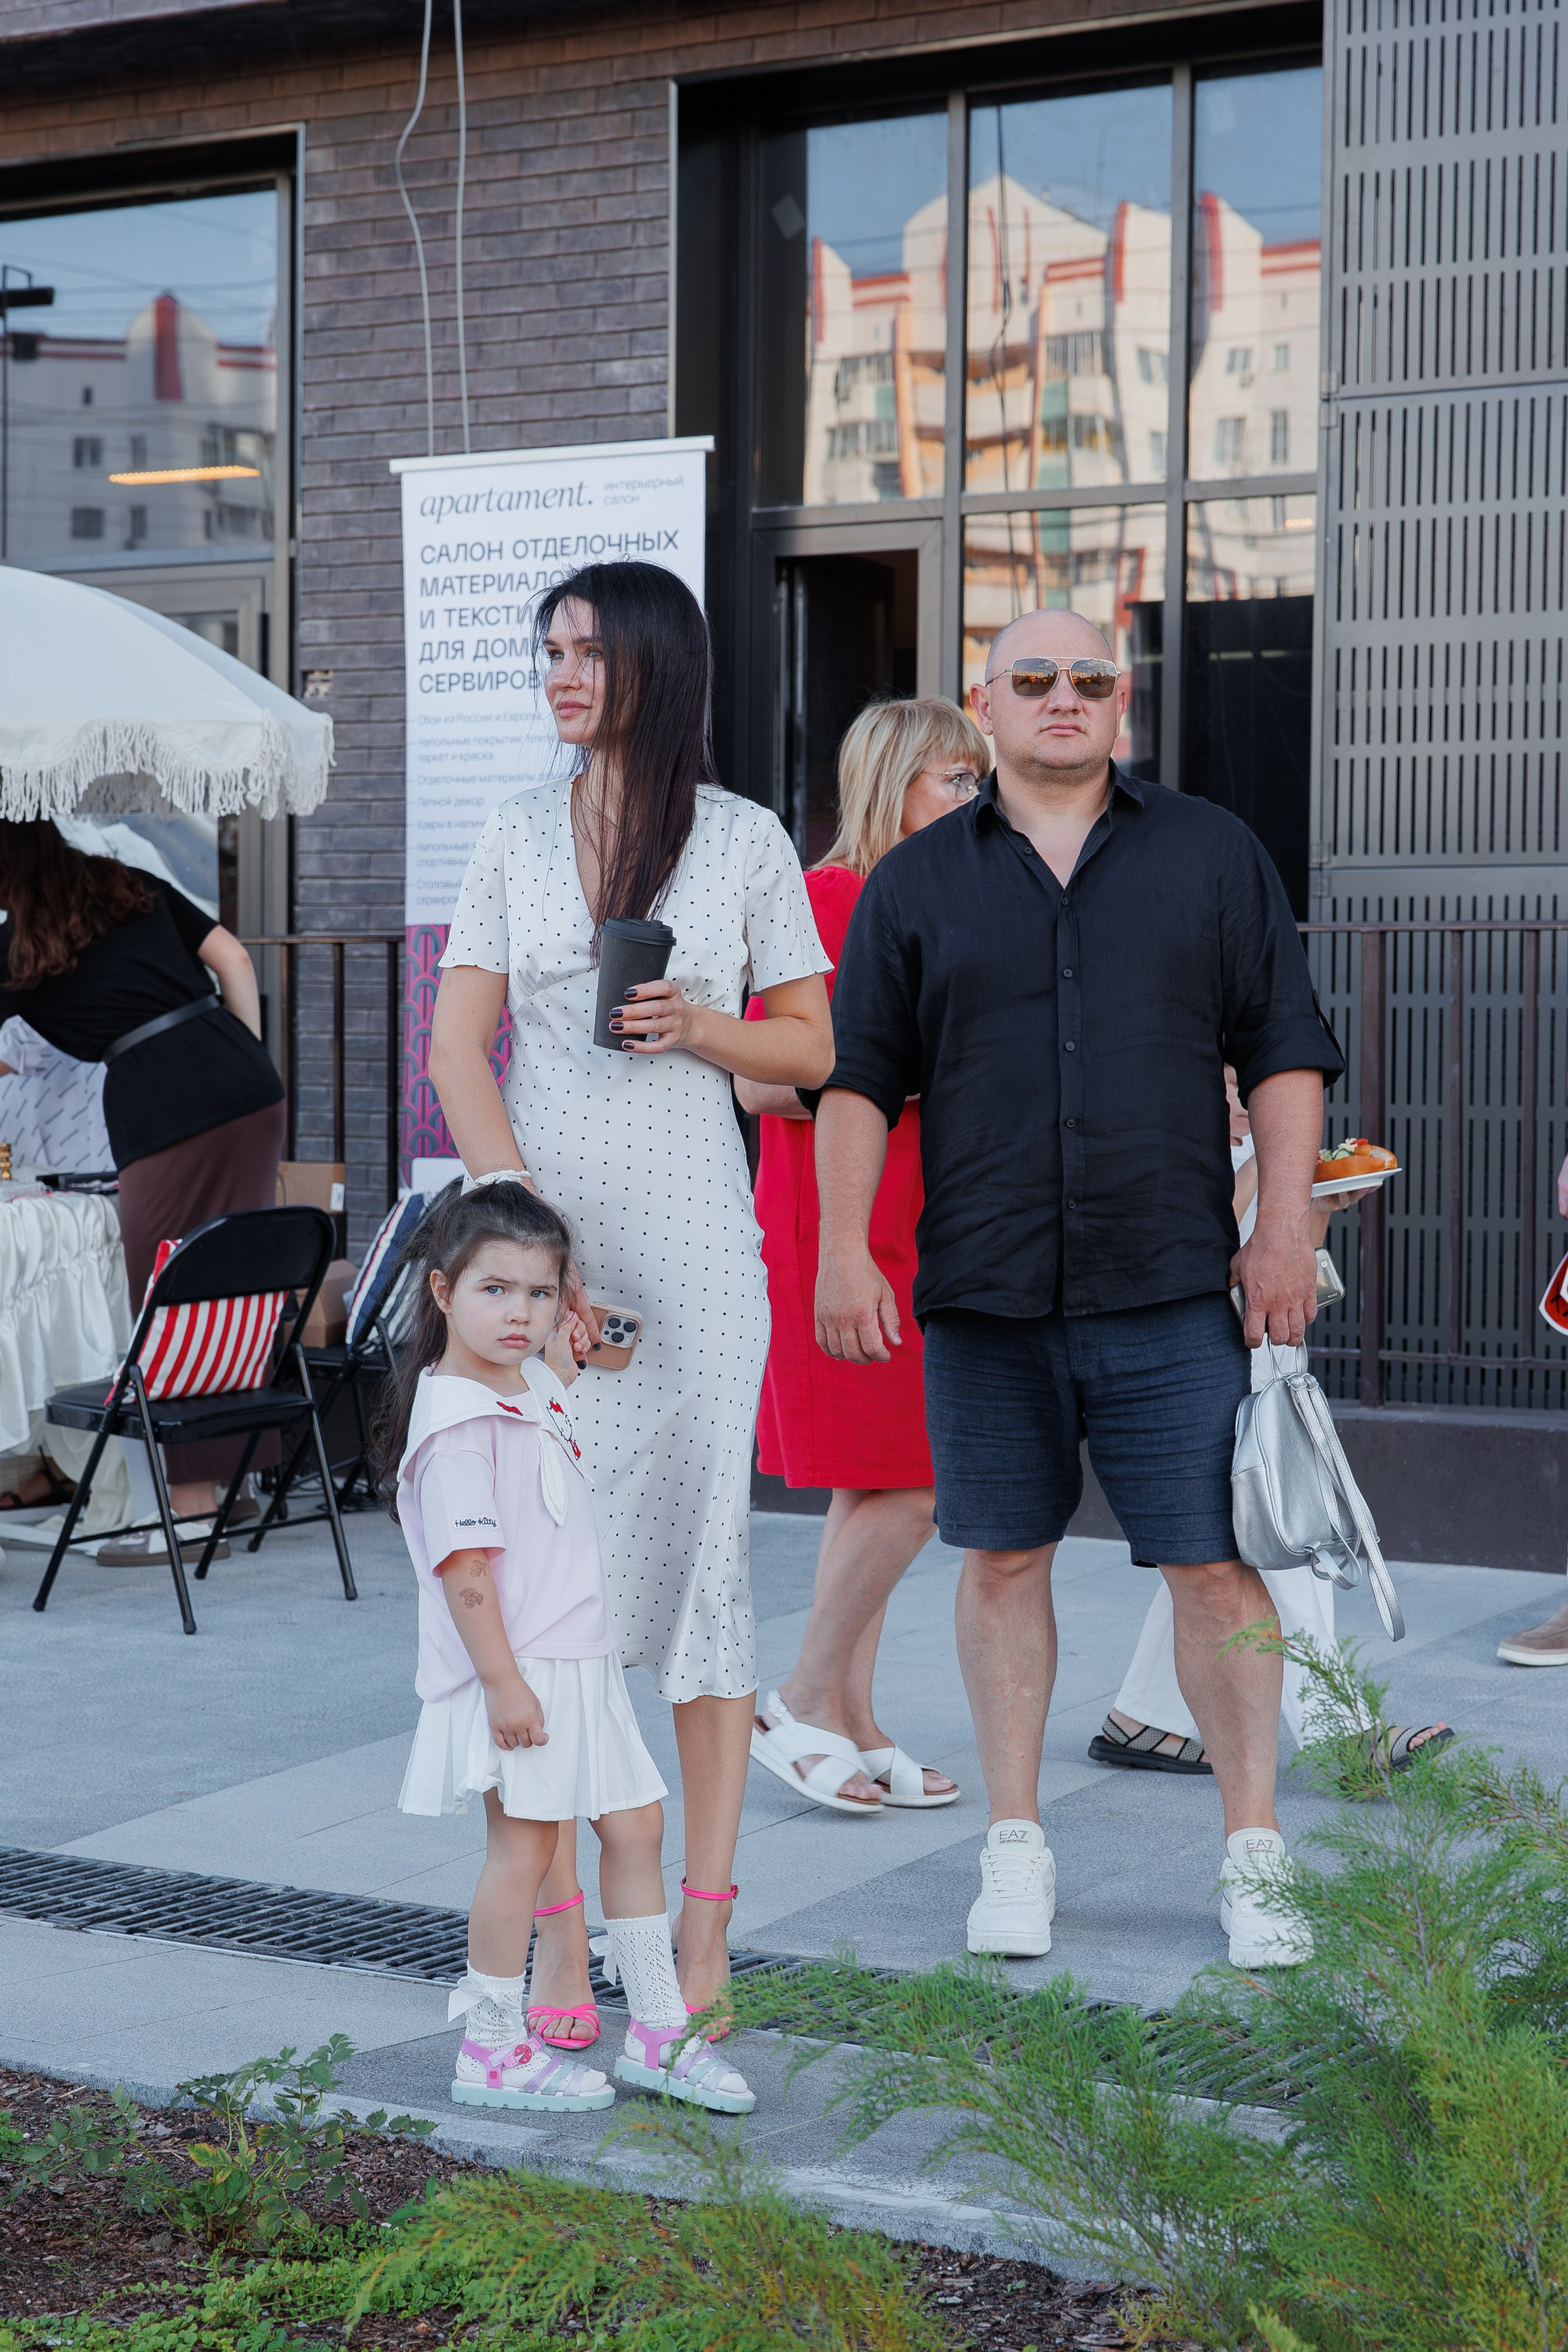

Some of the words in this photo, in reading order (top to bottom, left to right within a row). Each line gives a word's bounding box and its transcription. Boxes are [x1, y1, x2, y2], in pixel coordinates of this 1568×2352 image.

[420, 481, 593, 523] apartament.
[603, 495, 641, 506] салон
[421, 541, 503, 564] САЛОН
[512, 530, 679, 561] ОТДЕЛОЧНЫХ
[421, 611, 434, 629] И
[420, 641, 464, 665] ДЛЯ
[474, 637, 545, 662] ДОМ
[419, 670, 546, 693] СЕРВИРОВ
[455, 1519, 477, 1527] Hello
[477, 1517, 497, 1527] Kitty
[1000, 1830, 1029, 1840] EA7
[1247, 1839, 1274, 1849] EA7
